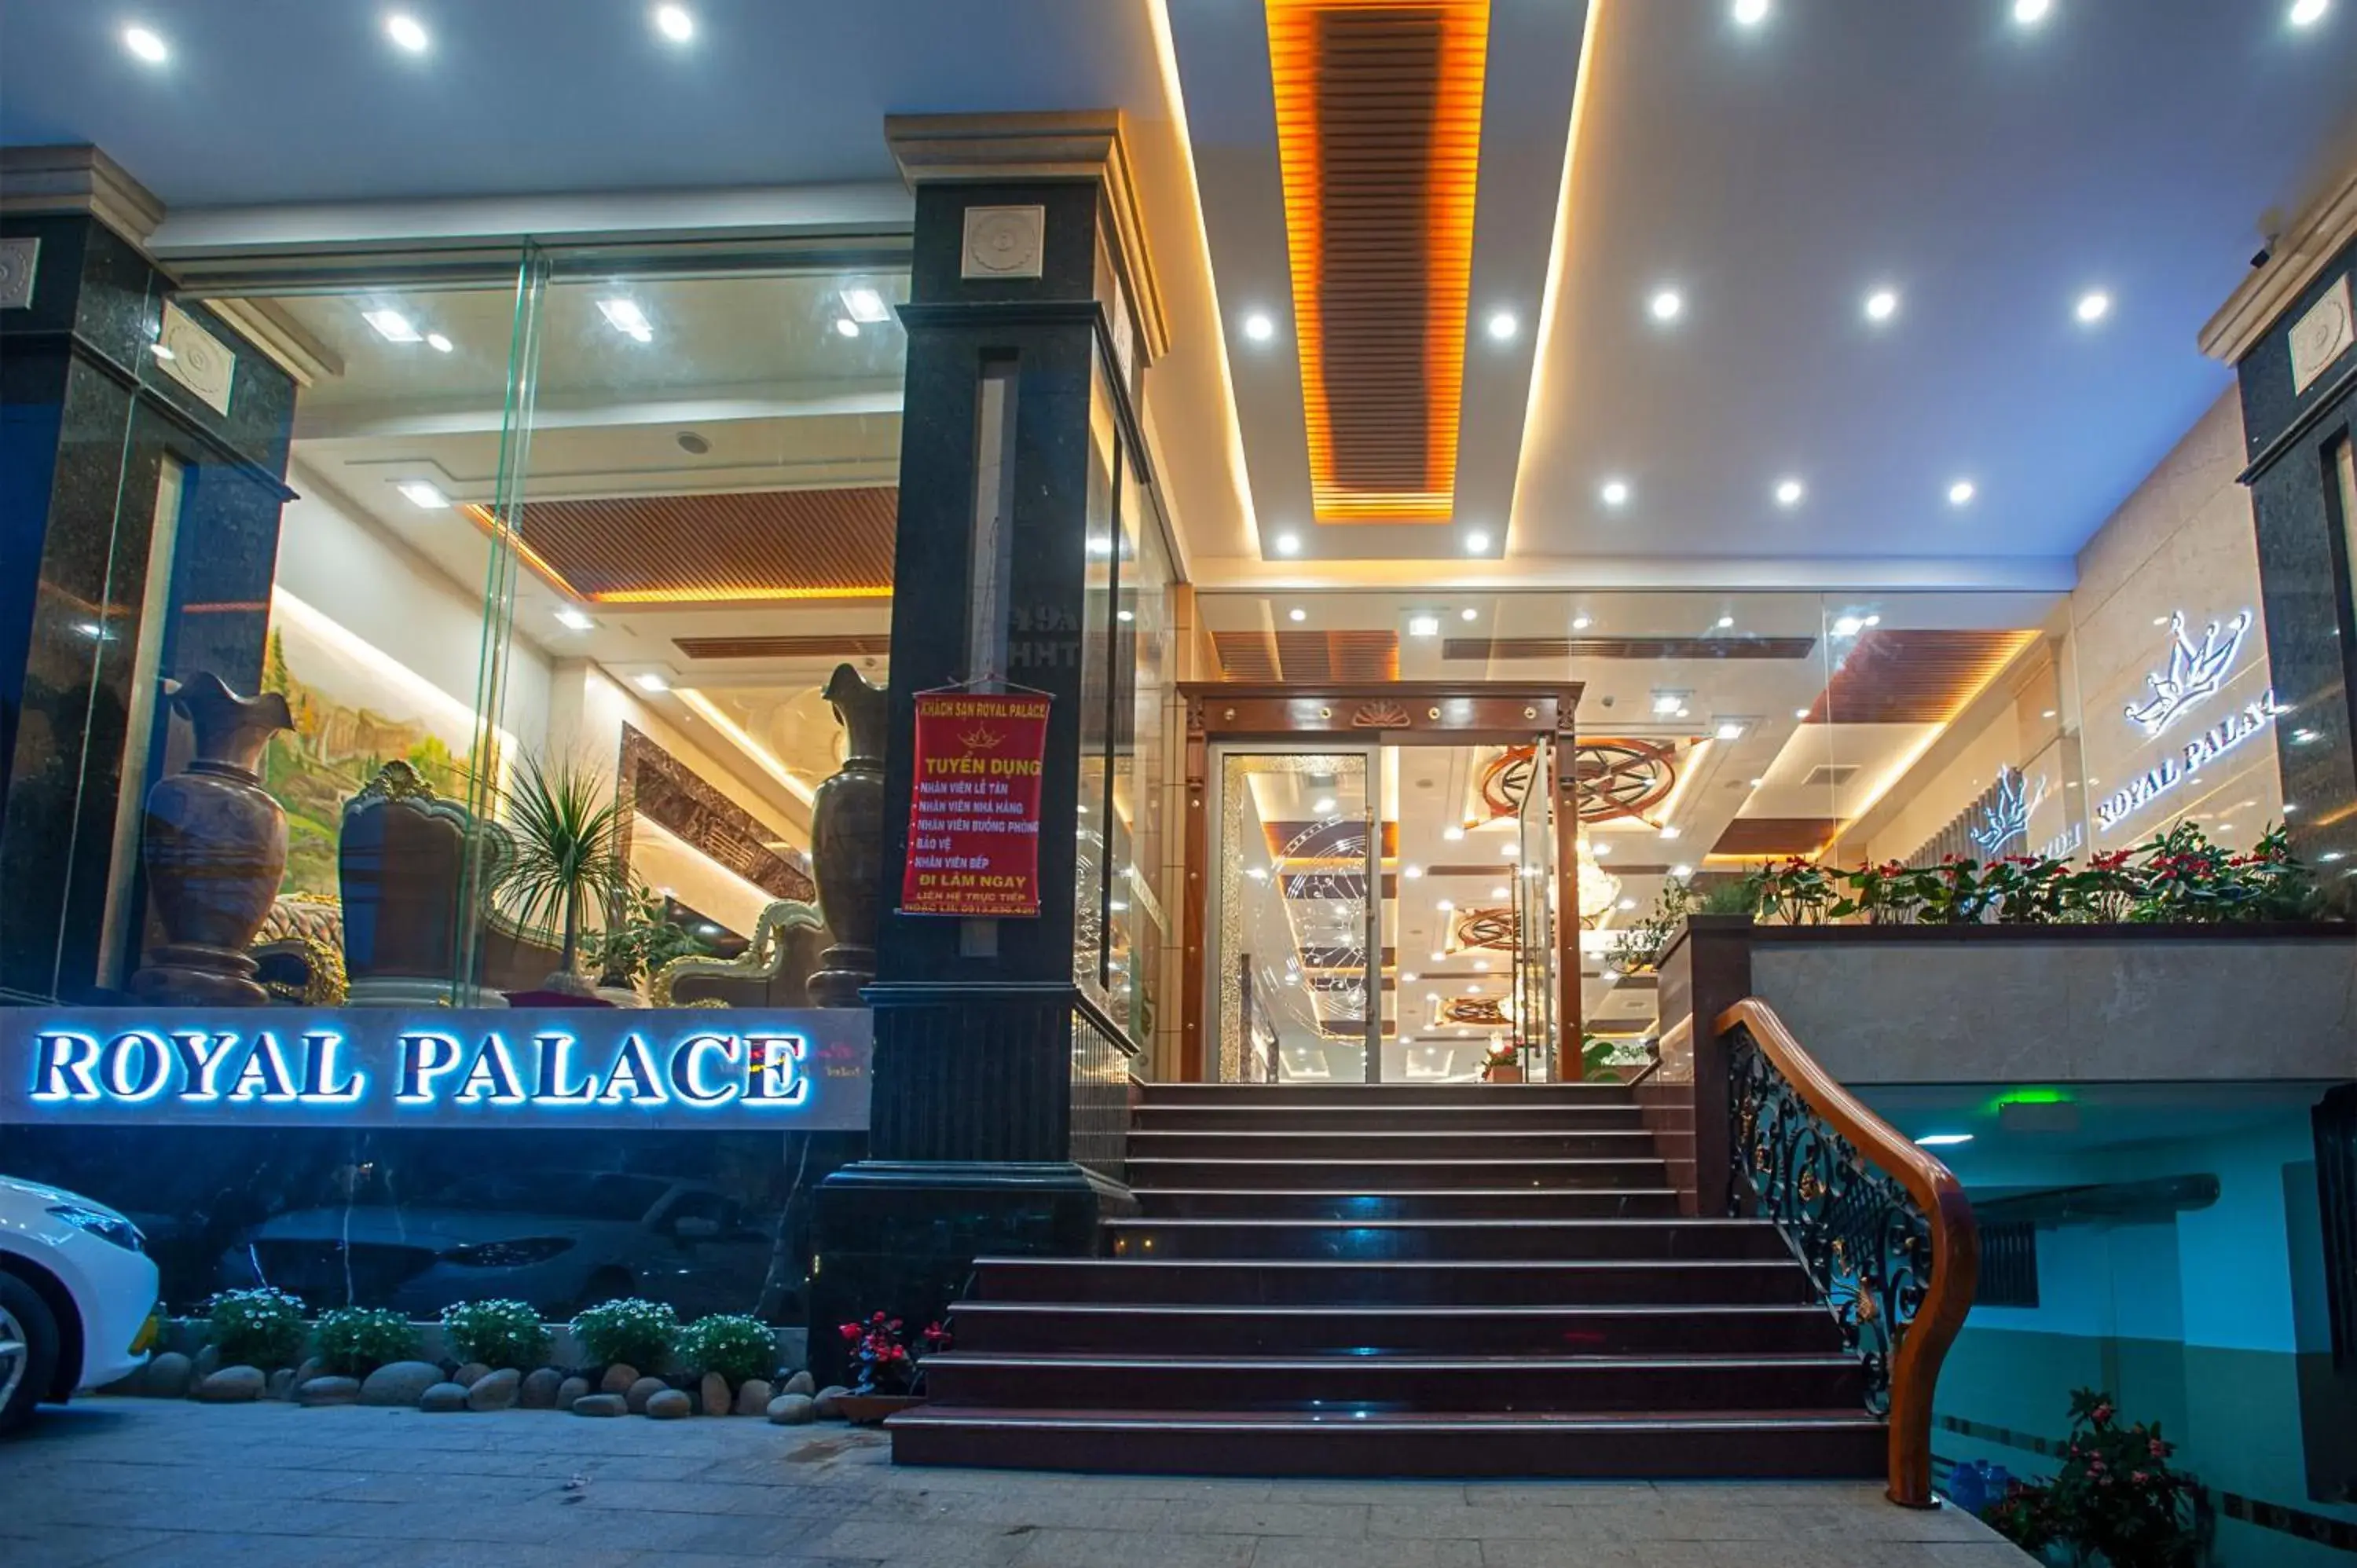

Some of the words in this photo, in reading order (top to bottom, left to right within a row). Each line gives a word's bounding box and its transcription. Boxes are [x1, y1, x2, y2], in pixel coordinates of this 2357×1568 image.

[976, 702, 1006, 718] ROYAL
[1010, 704, 1046, 719] PALACE
[992, 759, 1043, 779] DỤNG
[920, 781, 947, 793] NHÂN
[949, 781, 972, 794] VIÊN
[2097, 758, 2180, 833] ROYAL
[918, 799, 945, 811] NHÂN
[948, 799, 970, 812] VIÊN
[946, 818, 970, 831] VIÊN
[980, 876, 1027, 888] NGAY
[28, 1032, 363, 1100] ROYAL
[394, 1032, 806, 1103] PALACE
